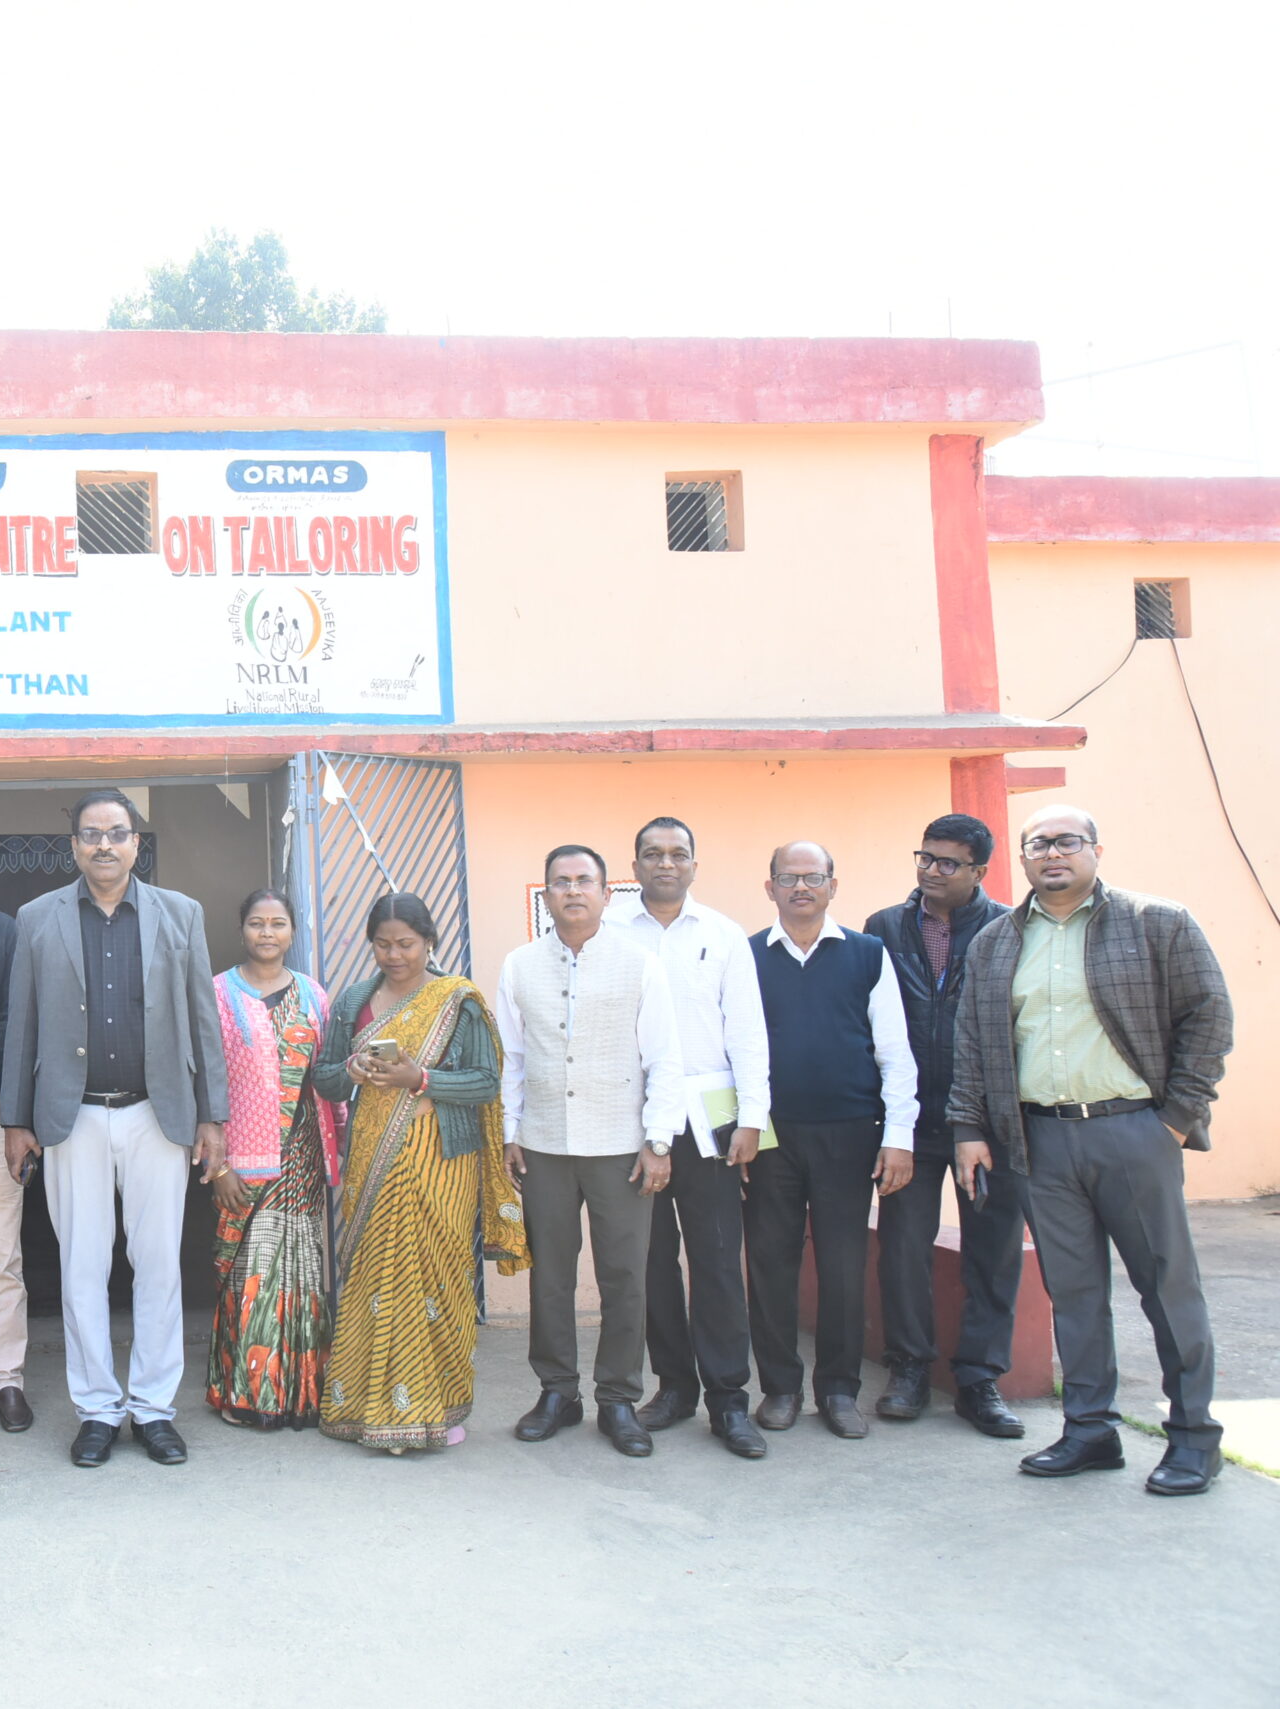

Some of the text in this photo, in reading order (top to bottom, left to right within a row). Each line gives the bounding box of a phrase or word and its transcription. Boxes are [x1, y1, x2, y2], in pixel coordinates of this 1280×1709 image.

[243, 465, 349, 485] ORMAS
[164, 516, 215, 576] ON
[224, 515, 419, 576] TAILORING
[236, 662, 308, 684] NRLM
[246, 688, 321, 703] National Rural
